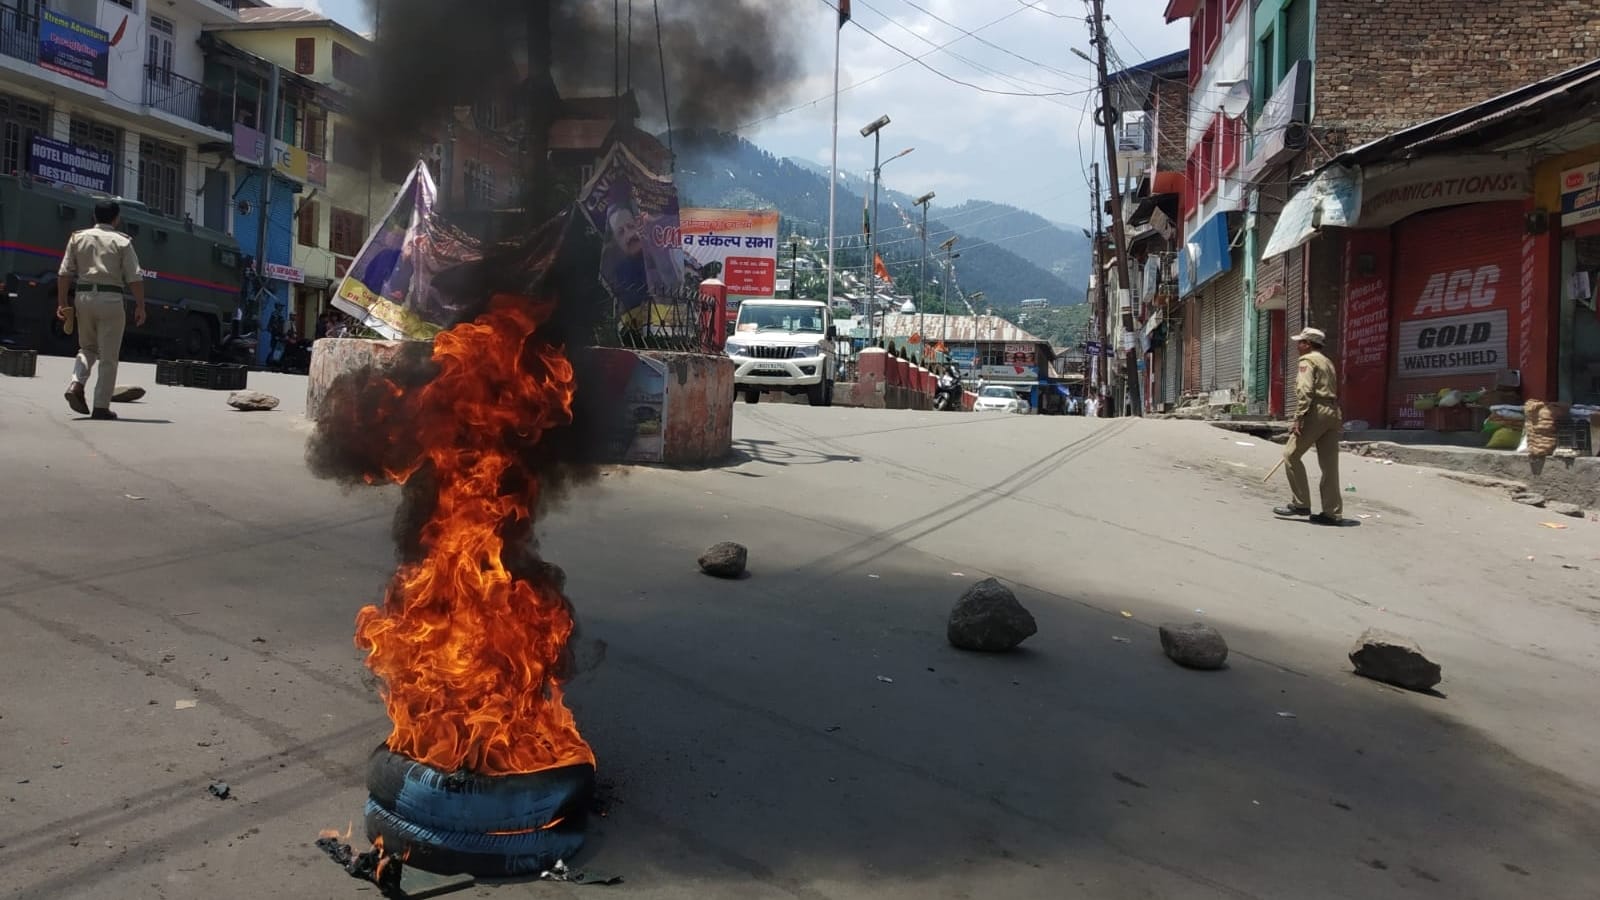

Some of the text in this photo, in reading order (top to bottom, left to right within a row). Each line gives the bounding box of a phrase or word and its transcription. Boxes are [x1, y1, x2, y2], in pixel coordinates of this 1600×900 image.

[32, 143, 60, 162] HOTEL
[62, 151, 111, 176] BROADWAY
[39, 164, 105, 190] RESTAURANT
[682, 231, 774, 248] व संकल्प सभा
[139, 269, 158, 279] OLICE
[1412, 265, 1500, 314] ACC
[1417, 321, 1491, 349] GOLD
